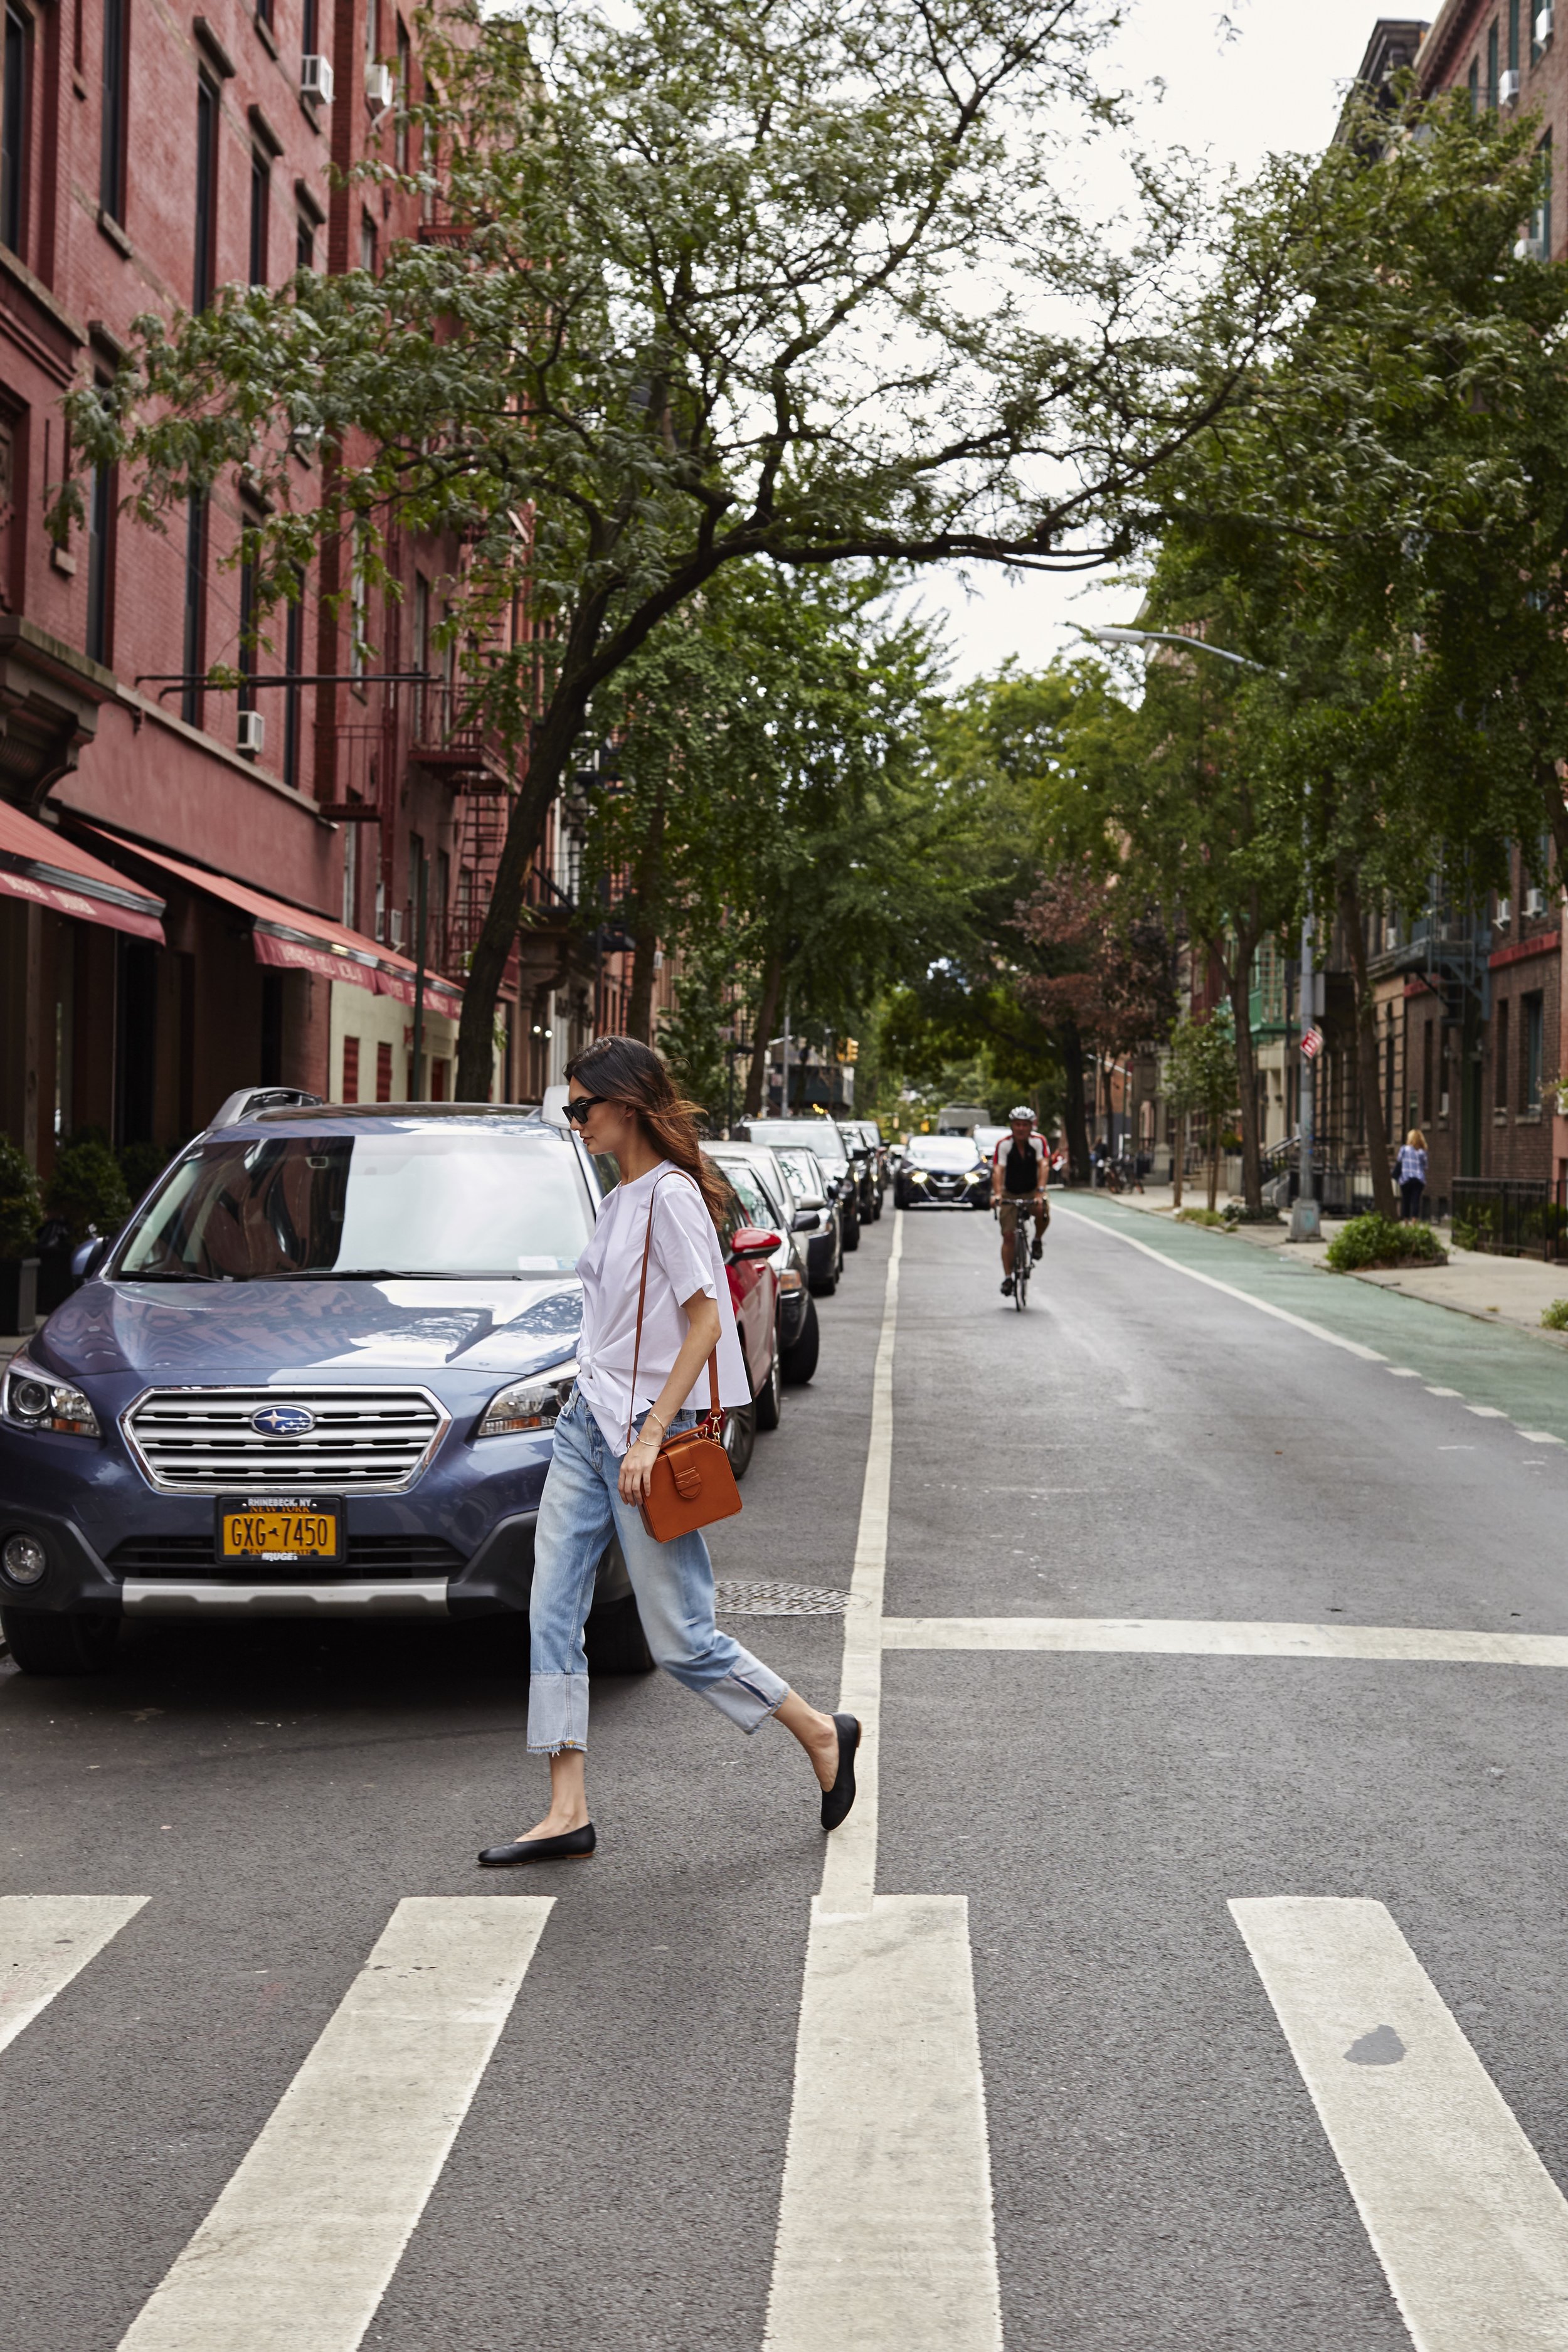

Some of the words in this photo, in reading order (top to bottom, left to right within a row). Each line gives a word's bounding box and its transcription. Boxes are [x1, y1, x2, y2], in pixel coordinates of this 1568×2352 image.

[248, 1498, 298, 1507] RHINEBECK,
[231, 1517, 266, 1547] GXG
[280, 1517, 327, 1547] 7450
